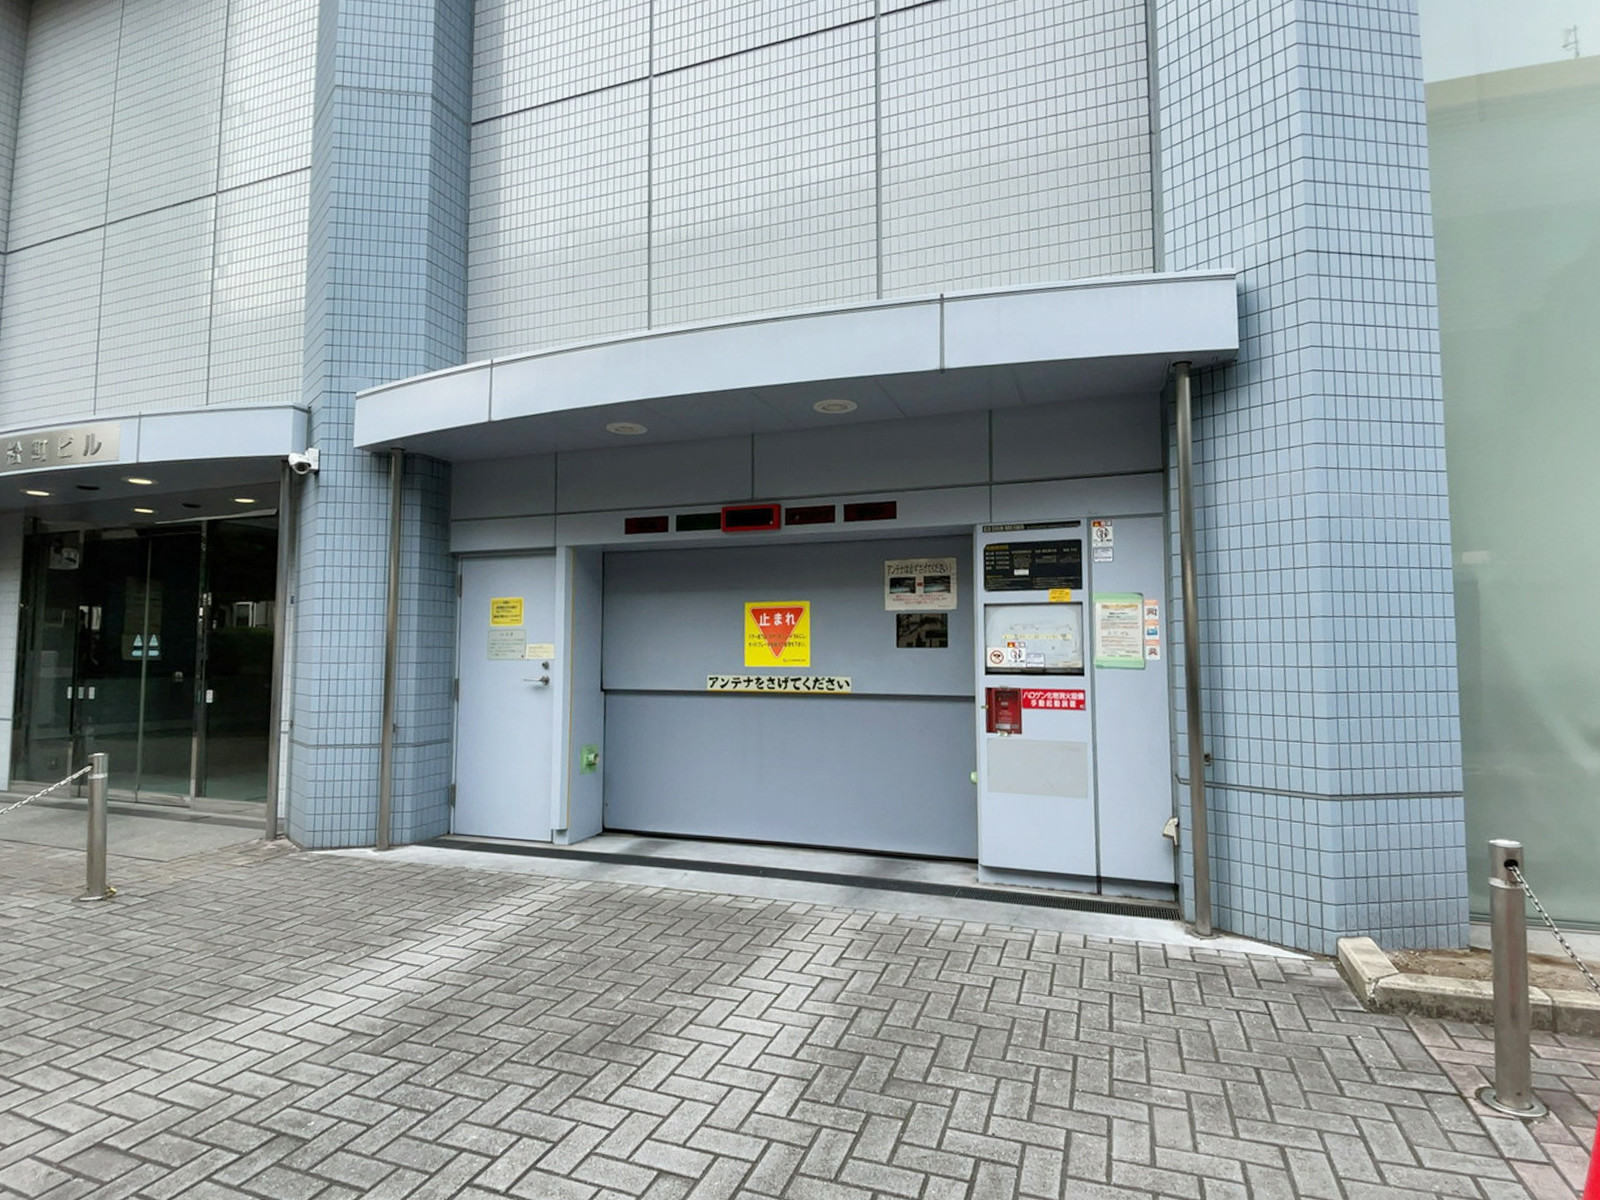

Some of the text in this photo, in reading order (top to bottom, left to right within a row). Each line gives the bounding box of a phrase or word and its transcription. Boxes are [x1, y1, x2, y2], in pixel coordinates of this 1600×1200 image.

[759, 612, 796, 627] 止まれ
[708, 676, 851, 691] アンテナをさげてください
